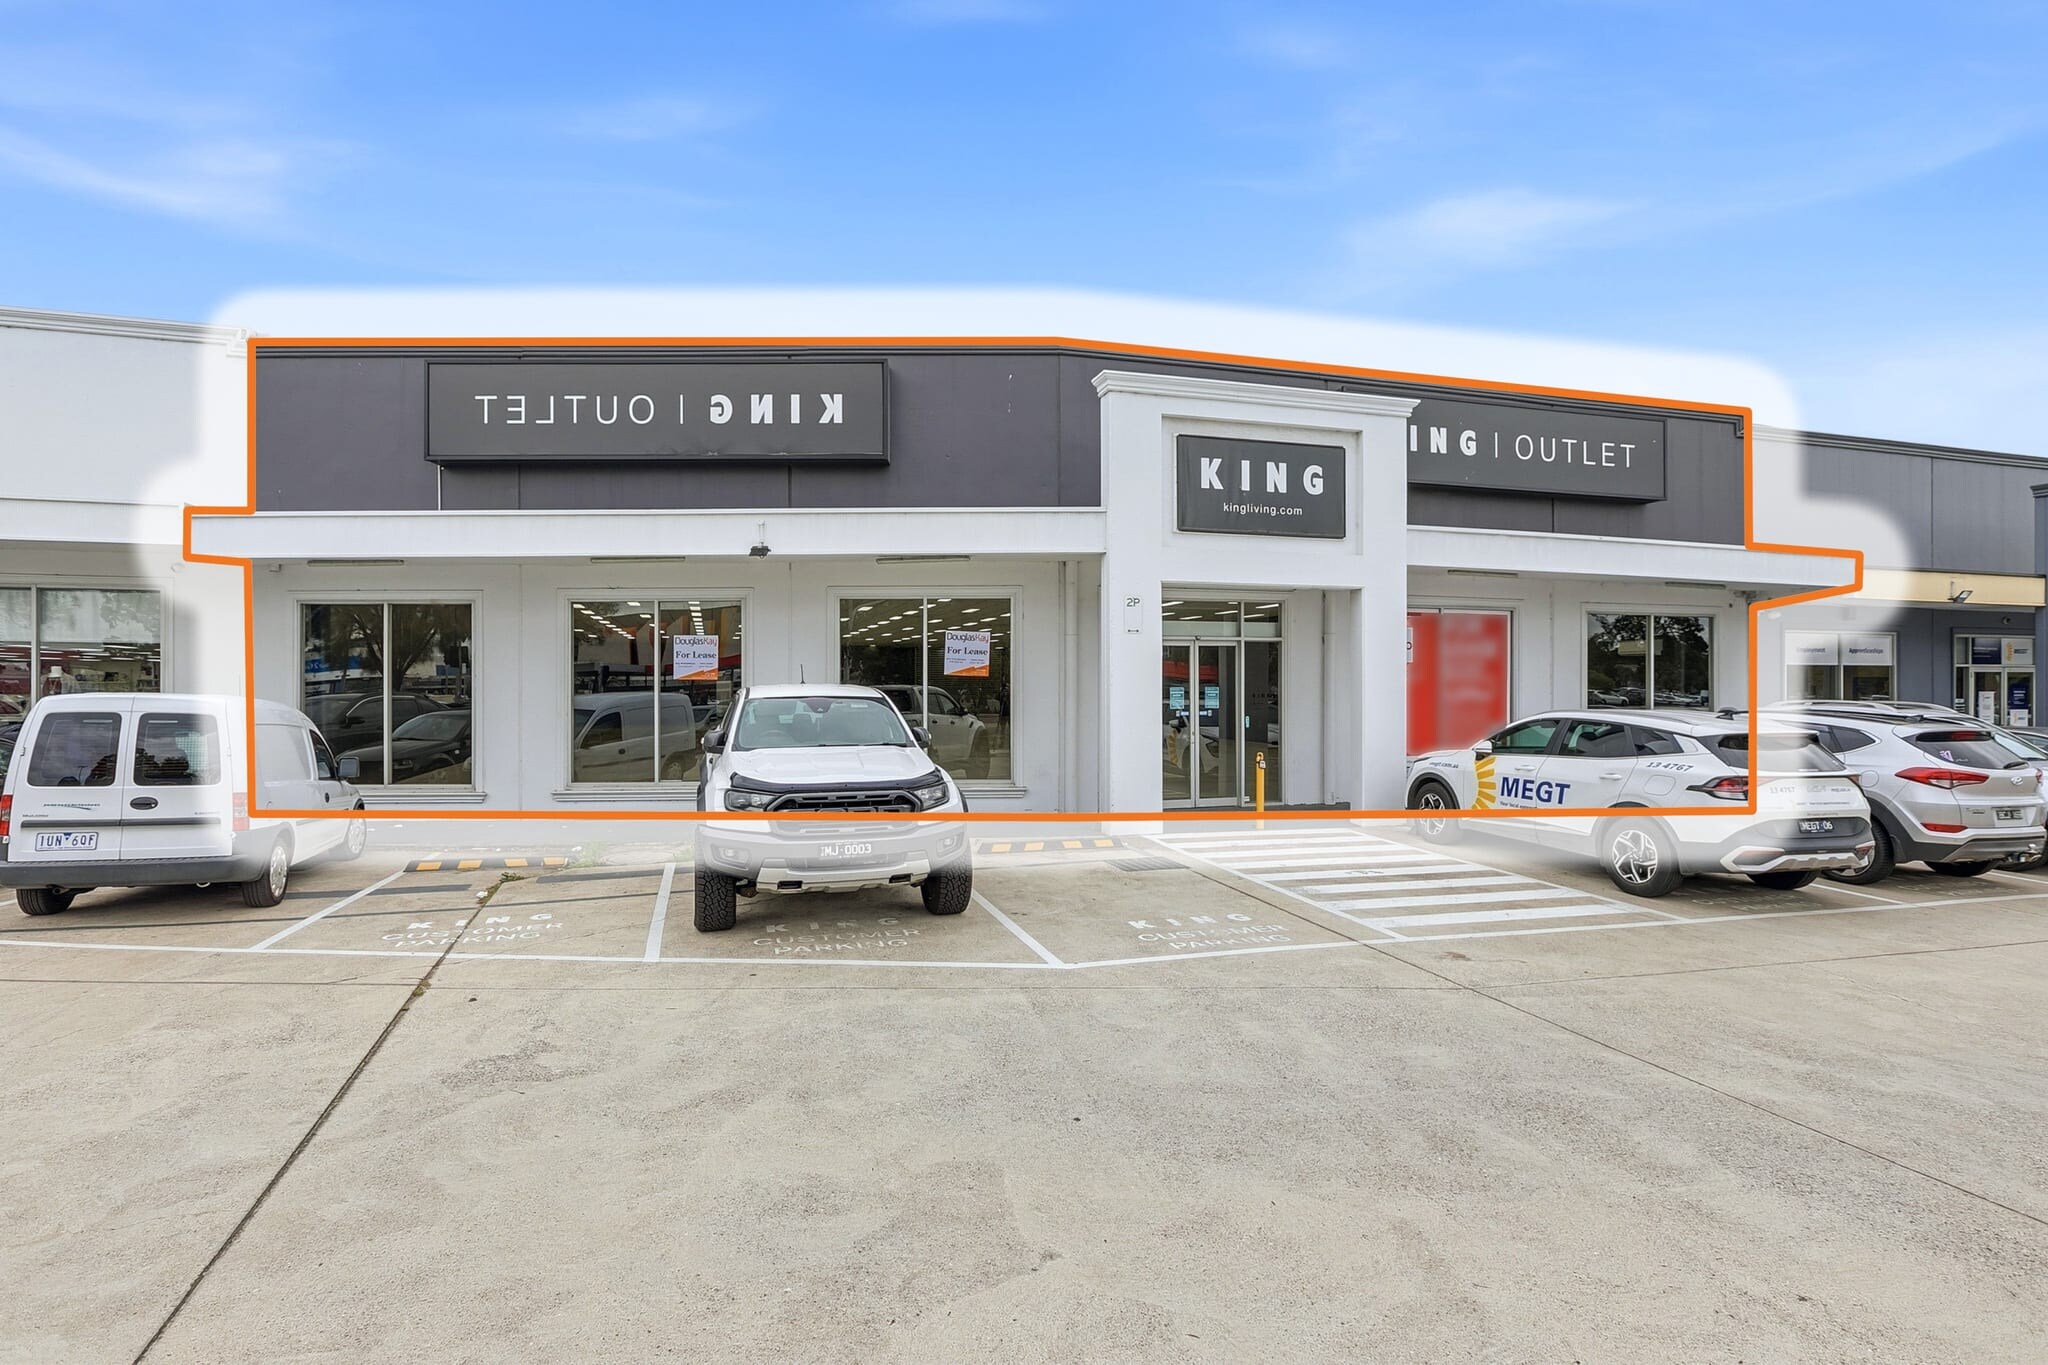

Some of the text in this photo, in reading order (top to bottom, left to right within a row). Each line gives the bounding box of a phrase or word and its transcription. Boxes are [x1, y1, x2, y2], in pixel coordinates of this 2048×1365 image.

[1408, 423, 1637, 469] ING OUTLET
[1200, 456, 1325, 496] KING
[1222, 502, 1304, 517] kingliving.com
[1126, 597, 1141, 607] 2P
[675, 650, 717, 659] For Lease
[947, 646, 989, 656] For Lease
[1500, 776, 1571, 804] MEGT
[407, 913, 553, 930] KING
[766, 917, 899, 933] KING
[1128, 913, 1252, 929] KING
[395, 931, 541, 948] PARKING
[753, 928, 921, 946] CUSTOMER
[1138, 924, 1289, 942] CUSTMER
[774, 938, 908, 955] PARKING
